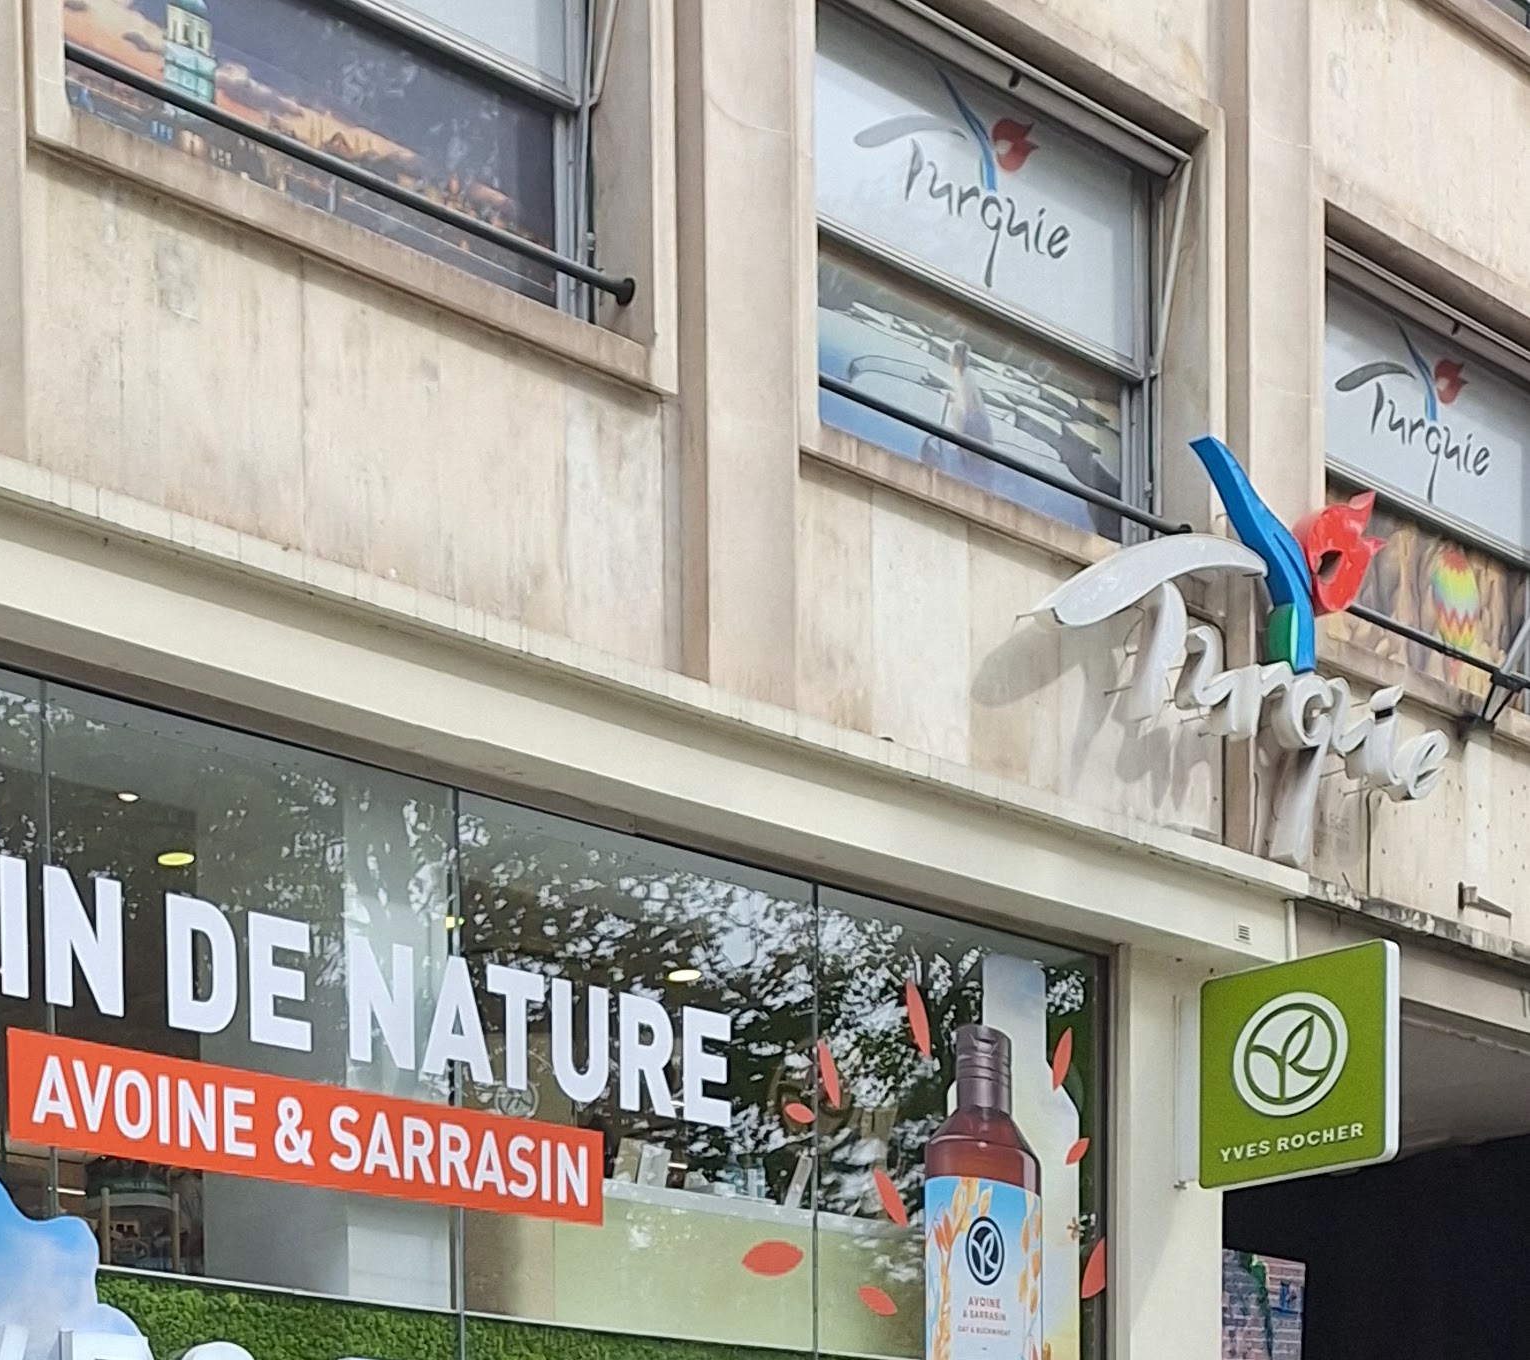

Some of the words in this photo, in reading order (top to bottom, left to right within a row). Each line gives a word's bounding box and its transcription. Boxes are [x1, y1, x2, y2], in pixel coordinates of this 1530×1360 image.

[853, 113, 1070, 287] Turquie
[1336, 361, 1492, 503] Turquie
[165, 891, 313, 1054] DE
[345, 934, 734, 1128] NATURE
[31, 1054, 256, 1159] AVOINE
[273, 1094, 315, 1168] &
[329, 1105, 589, 1208] SARRASIN
[1220, 1140, 1271, 1162] YVES
[1276, 1122, 1364, 1152] ROCHER
